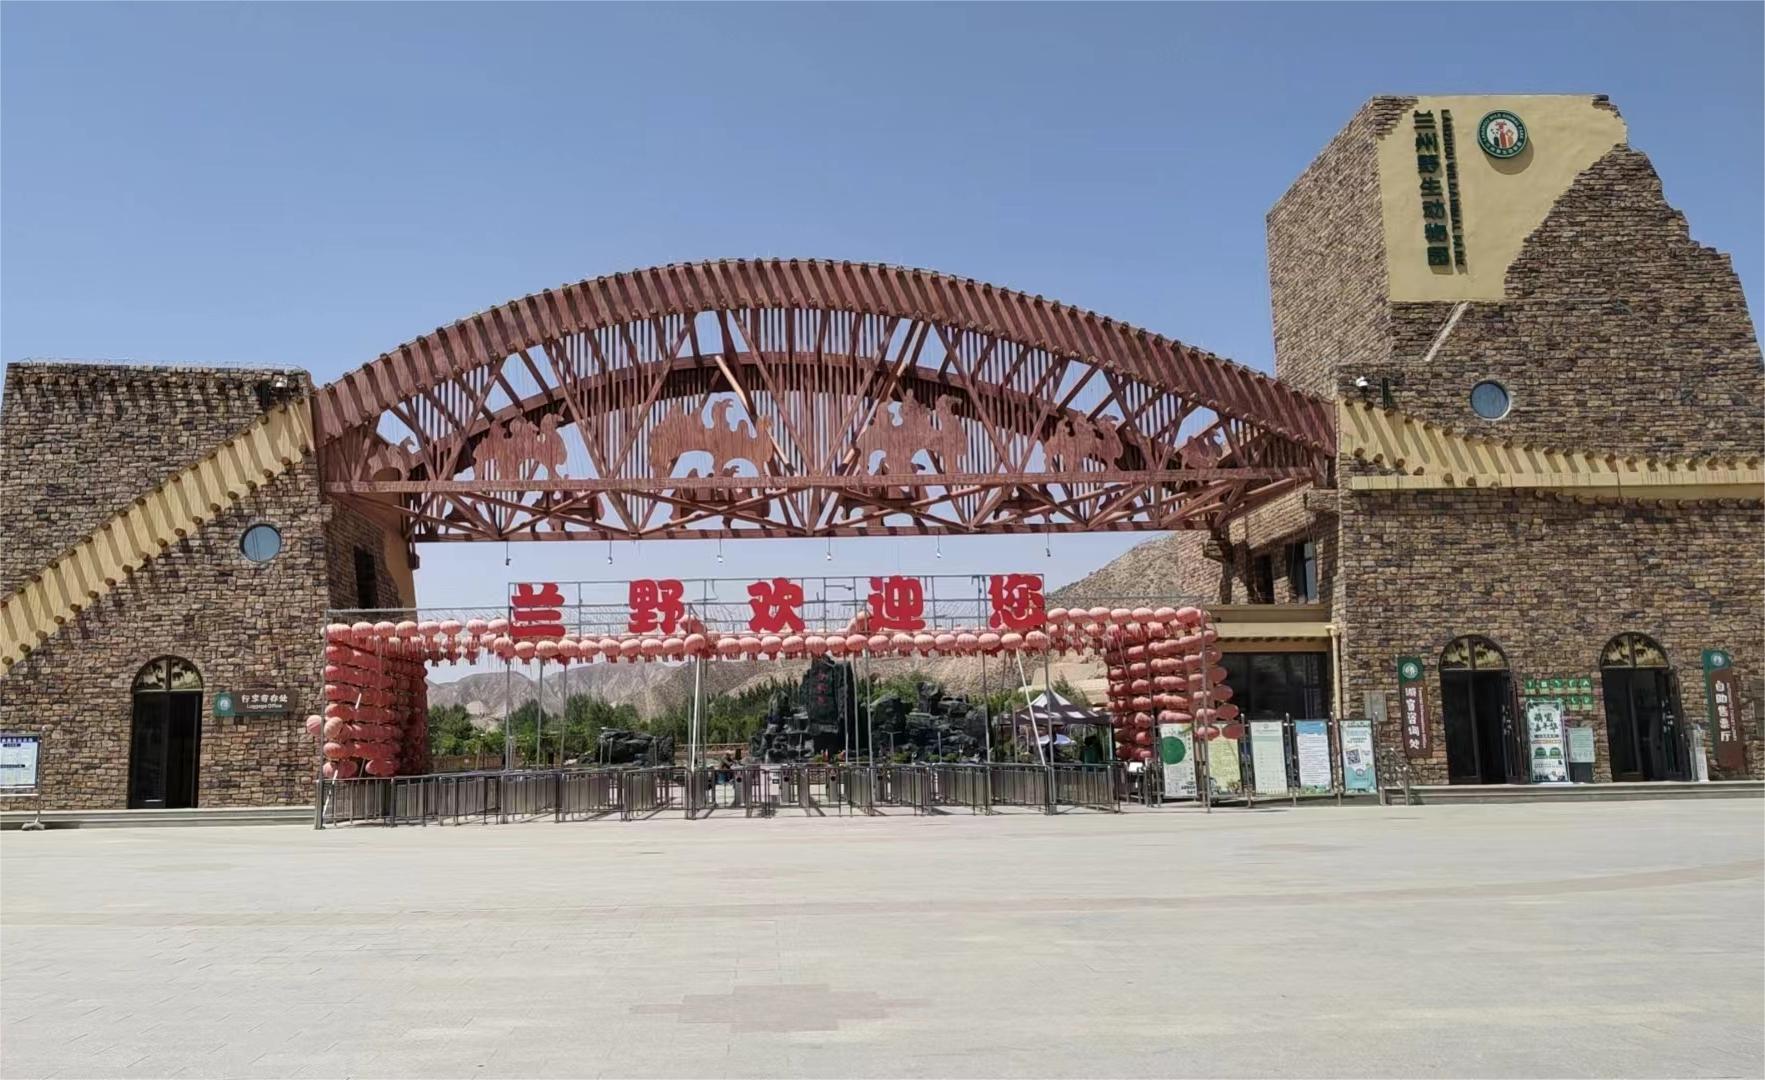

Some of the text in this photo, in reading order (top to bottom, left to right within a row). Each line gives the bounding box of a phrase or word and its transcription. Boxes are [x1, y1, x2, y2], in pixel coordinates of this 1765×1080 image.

[1441, 109, 1455, 159] LANZHOU
[1413, 110, 1450, 266] 兰州野生动物园
[1447, 162, 1457, 189] WILD
[1453, 235, 1464, 265] PARK
[509, 573, 1047, 638] 兰野欢迎您
[241, 694, 289, 703] 行李寄存处
[1405, 687, 1421, 750] 游客咨询处
[1715, 680, 1732, 742] 自助售票厅
